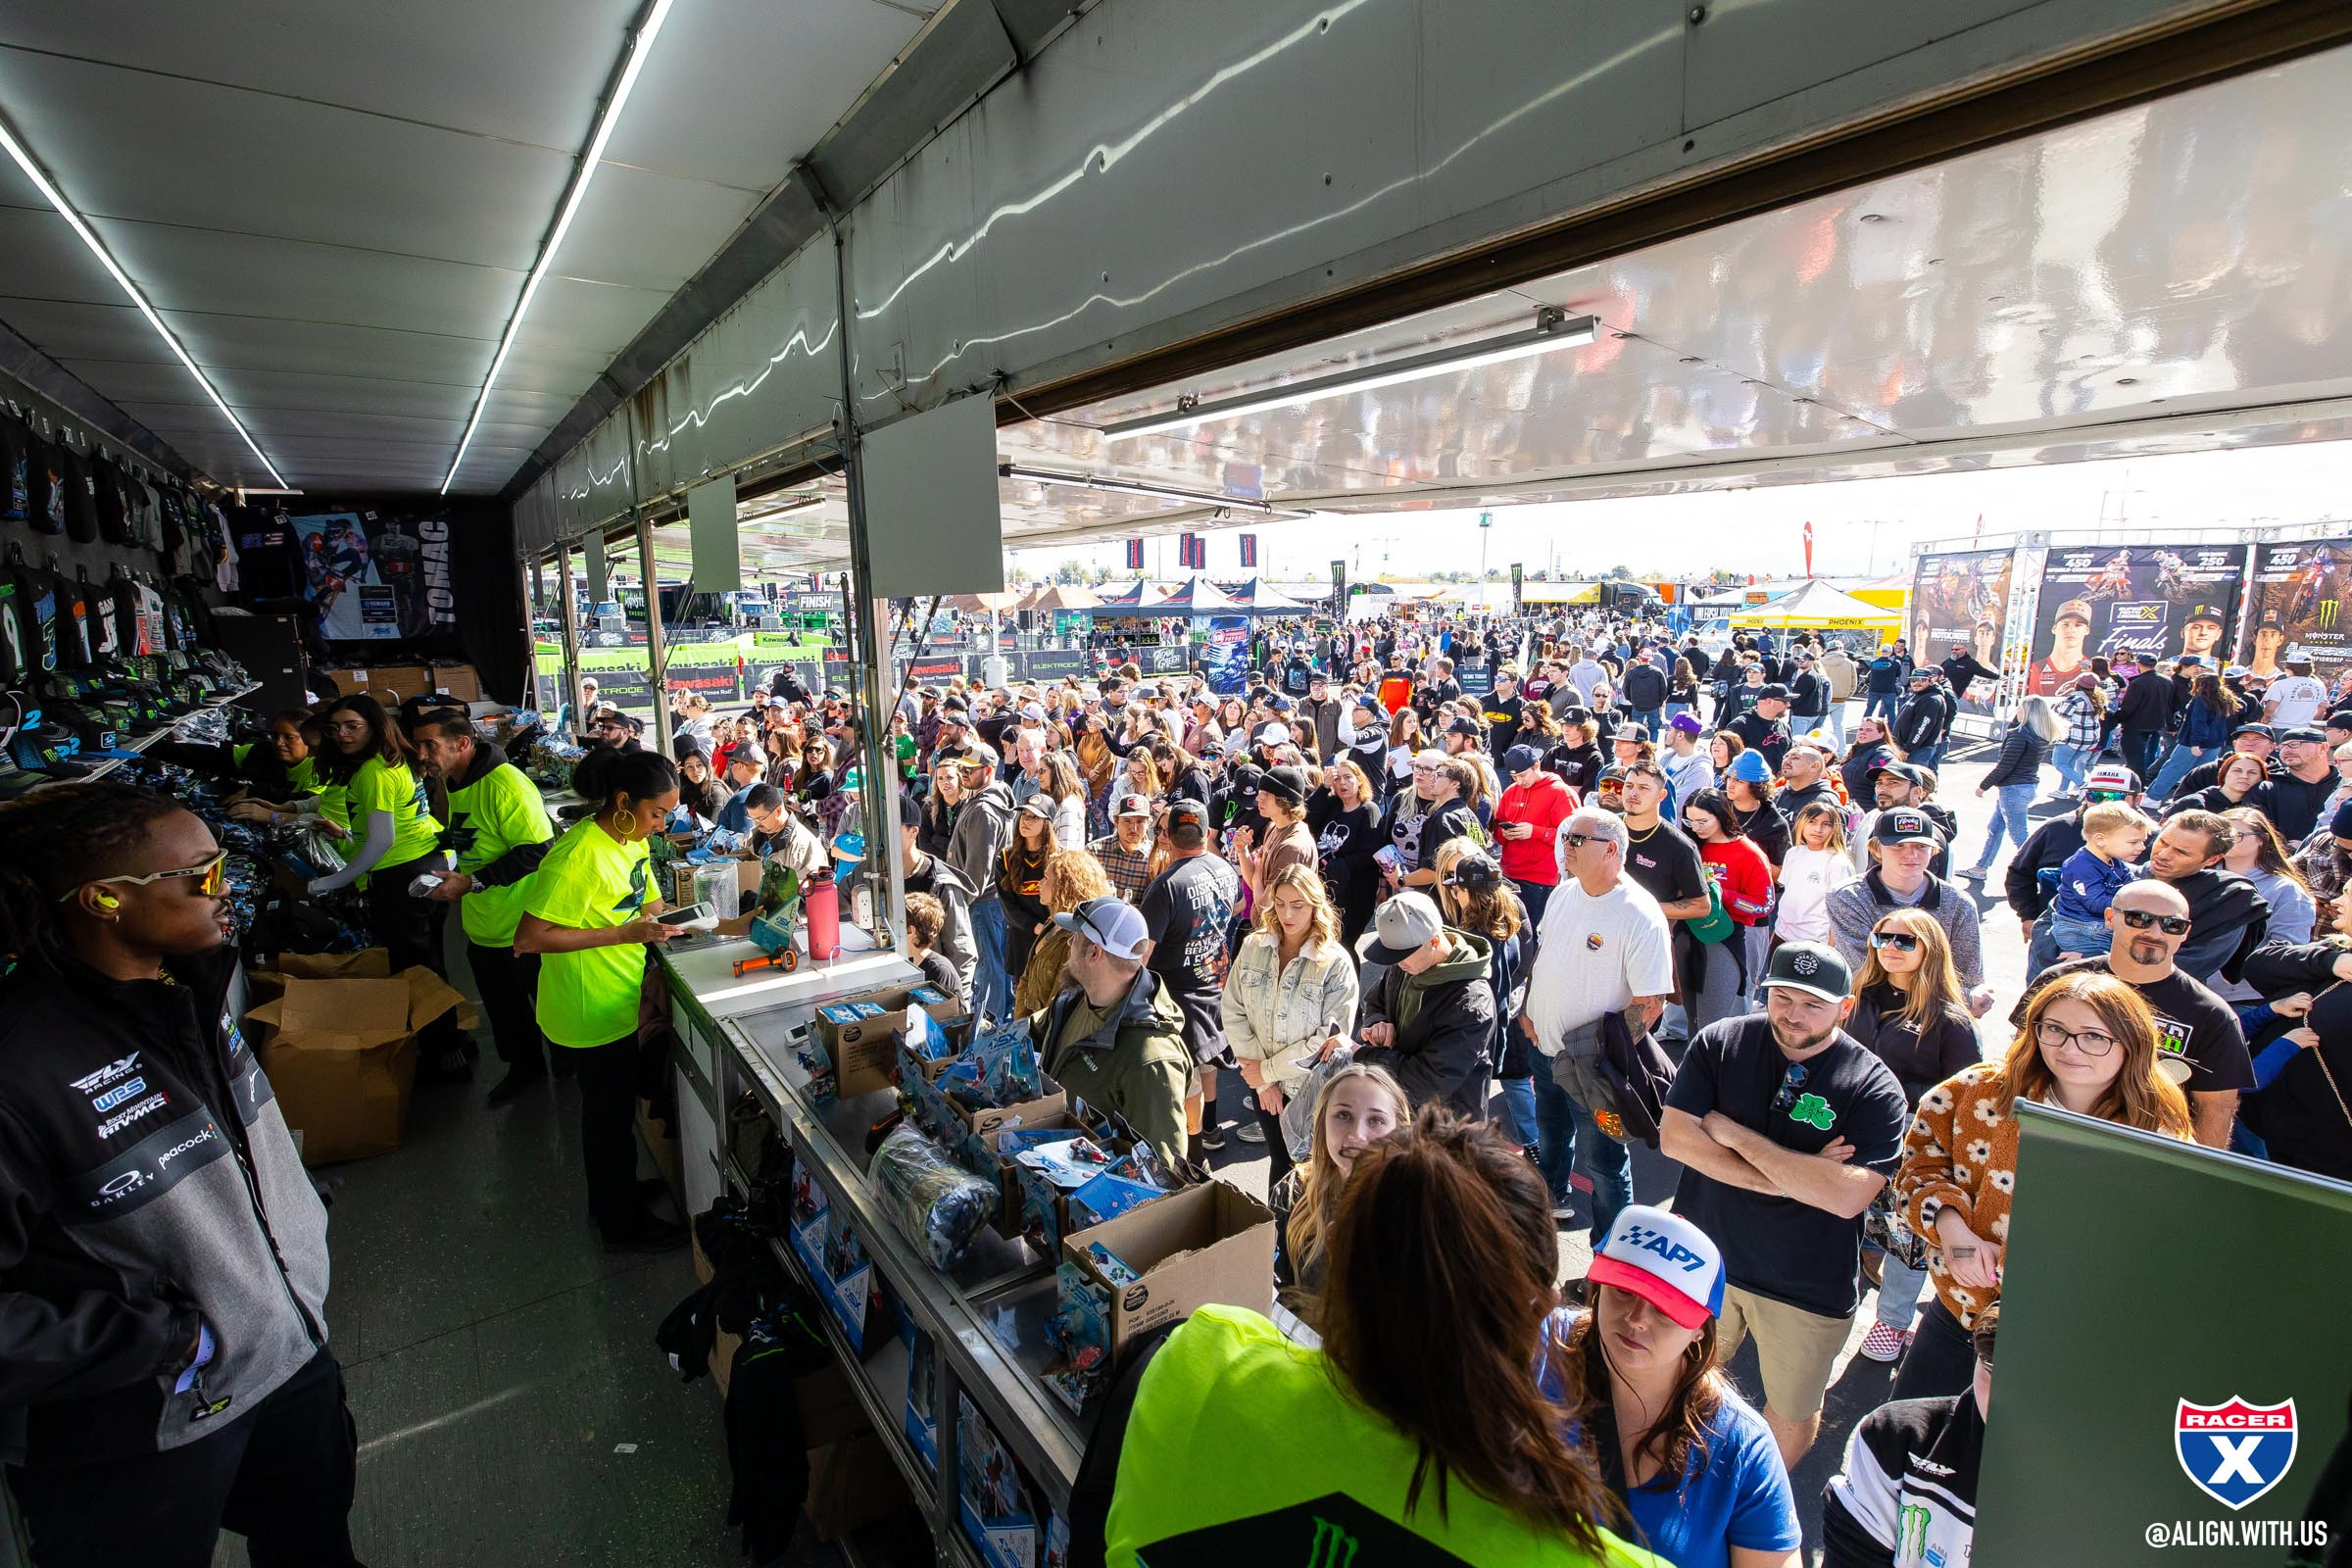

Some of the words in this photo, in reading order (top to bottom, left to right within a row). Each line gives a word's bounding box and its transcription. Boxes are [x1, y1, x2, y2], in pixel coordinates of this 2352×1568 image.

[2064, 559, 2091, 567] 450
[2270, 554, 2297, 564] 450
[418, 521, 456, 624] TOMAC
[800, 596, 832, 609] FINISH
[2097, 625, 2169, 652] Finals
[2287, 647, 2352, 656] SUPERCROS
[1033, 661, 1079, 669] ELEKTRODE
[22, 710, 42, 731] 2
[1192, 891, 1214, 910] OUR
[1183, 956, 1191, 967] A
[1185, 944, 1209, 956] BEEN
[70, 1051, 140, 1089] FLY
[84, 1067, 134, 1095] RACING
[92, 1076, 147, 1111] WPS
[106, 1110, 126, 1126] ROCKY
[126, 1092, 163, 1114] MOUNTAIN
[158, 1129, 213, 1170] peacock
[90, 1172, 154, 1206] OAKLEY
[1642, 1236, 1706, 1272] AP7
